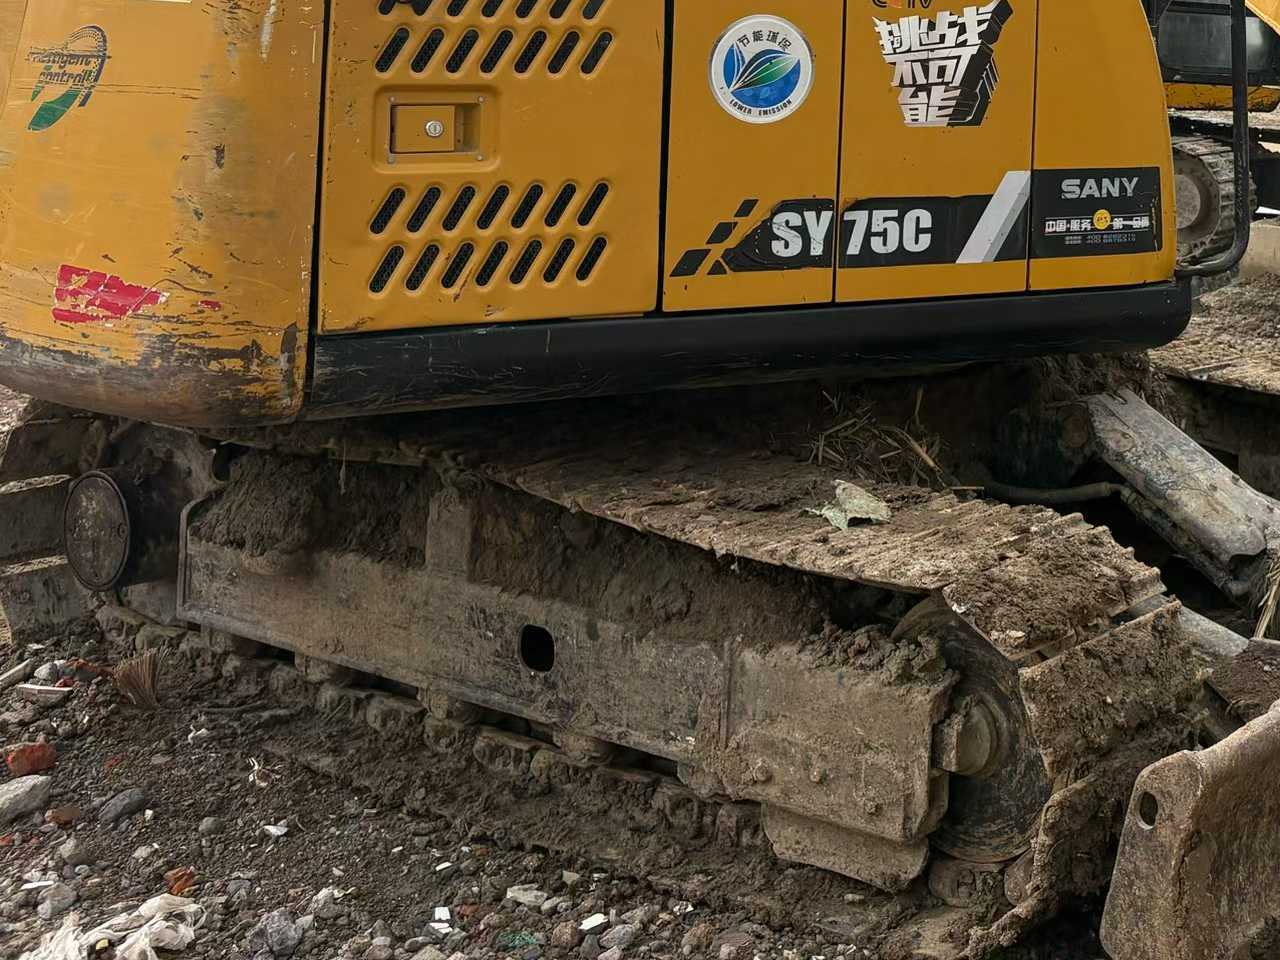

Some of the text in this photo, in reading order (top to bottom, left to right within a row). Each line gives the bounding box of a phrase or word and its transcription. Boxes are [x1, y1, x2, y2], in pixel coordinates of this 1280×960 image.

[736, 29, 793, 52] 节能环保
[1060, 176, 1139, 200] SANY
